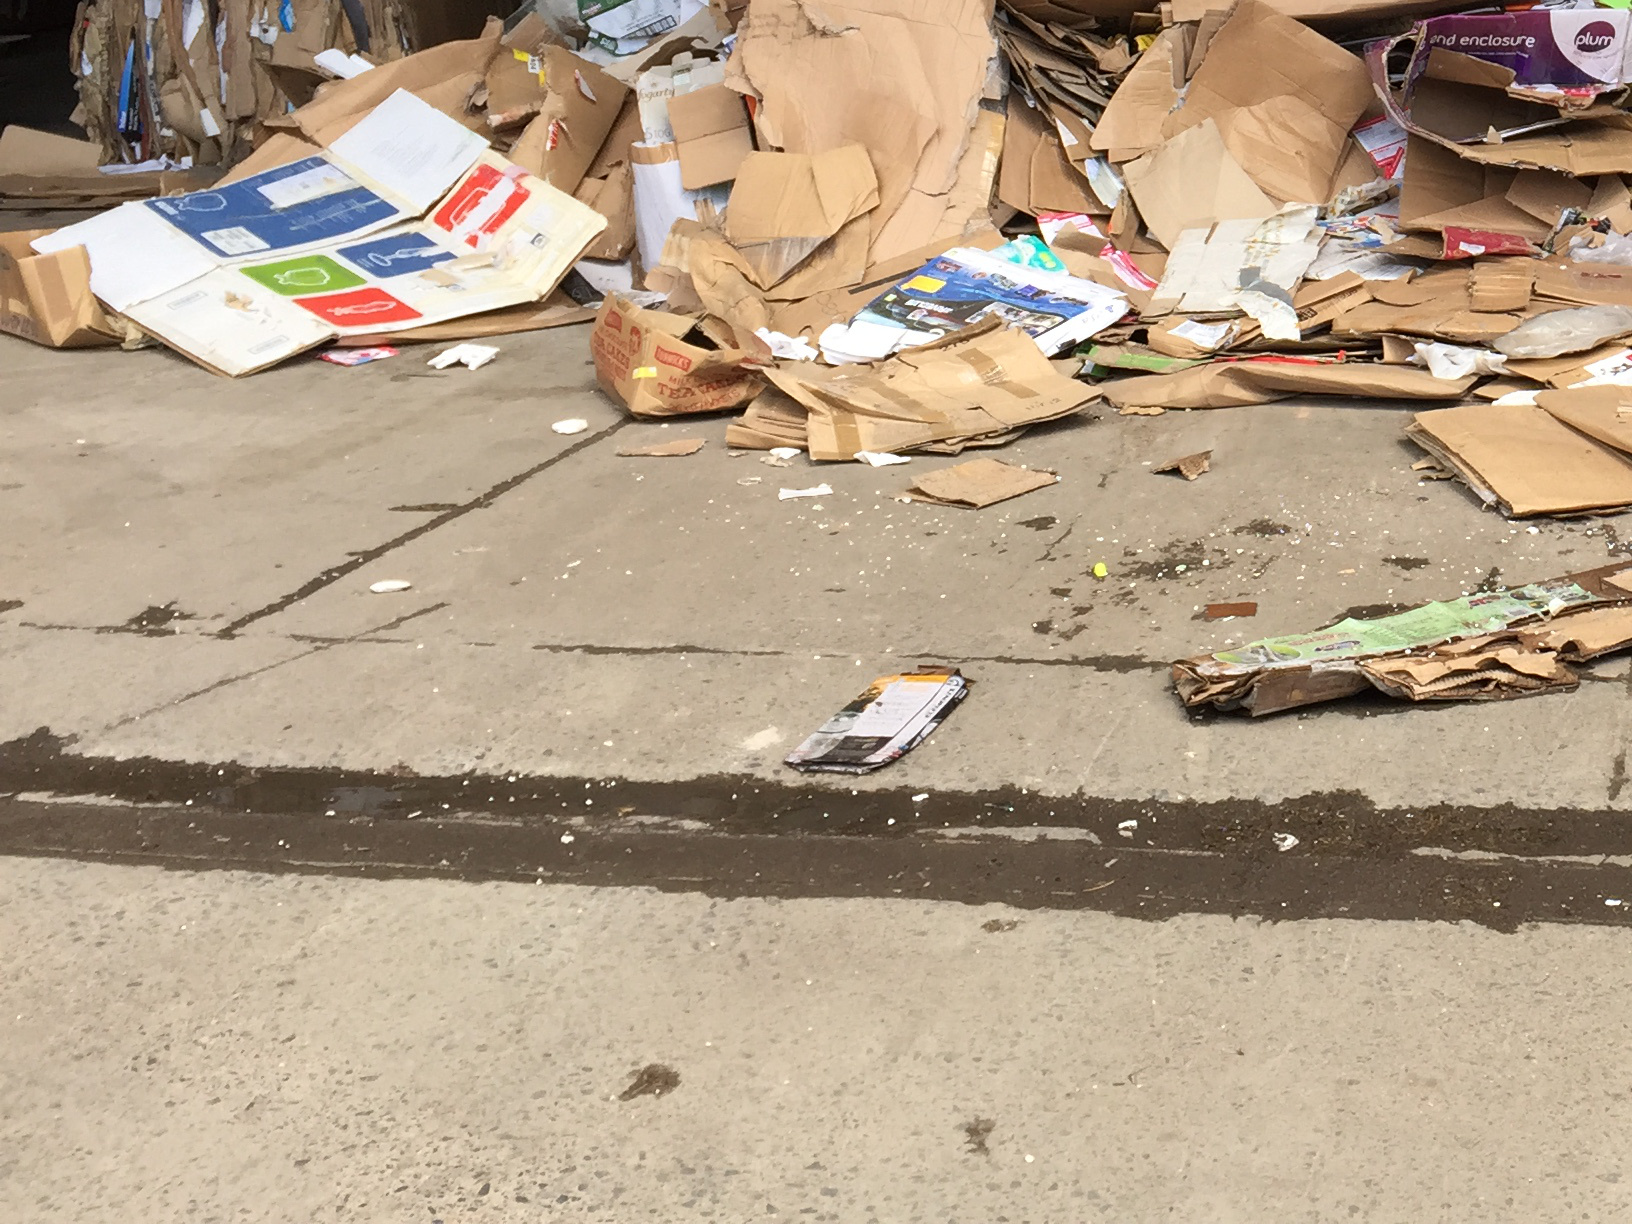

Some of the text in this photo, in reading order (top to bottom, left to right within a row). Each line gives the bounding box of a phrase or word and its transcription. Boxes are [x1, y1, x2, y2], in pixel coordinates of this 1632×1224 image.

[1430, 34, 1535, 48] and enclosure
[1575, 31, 1615, 47] plum
